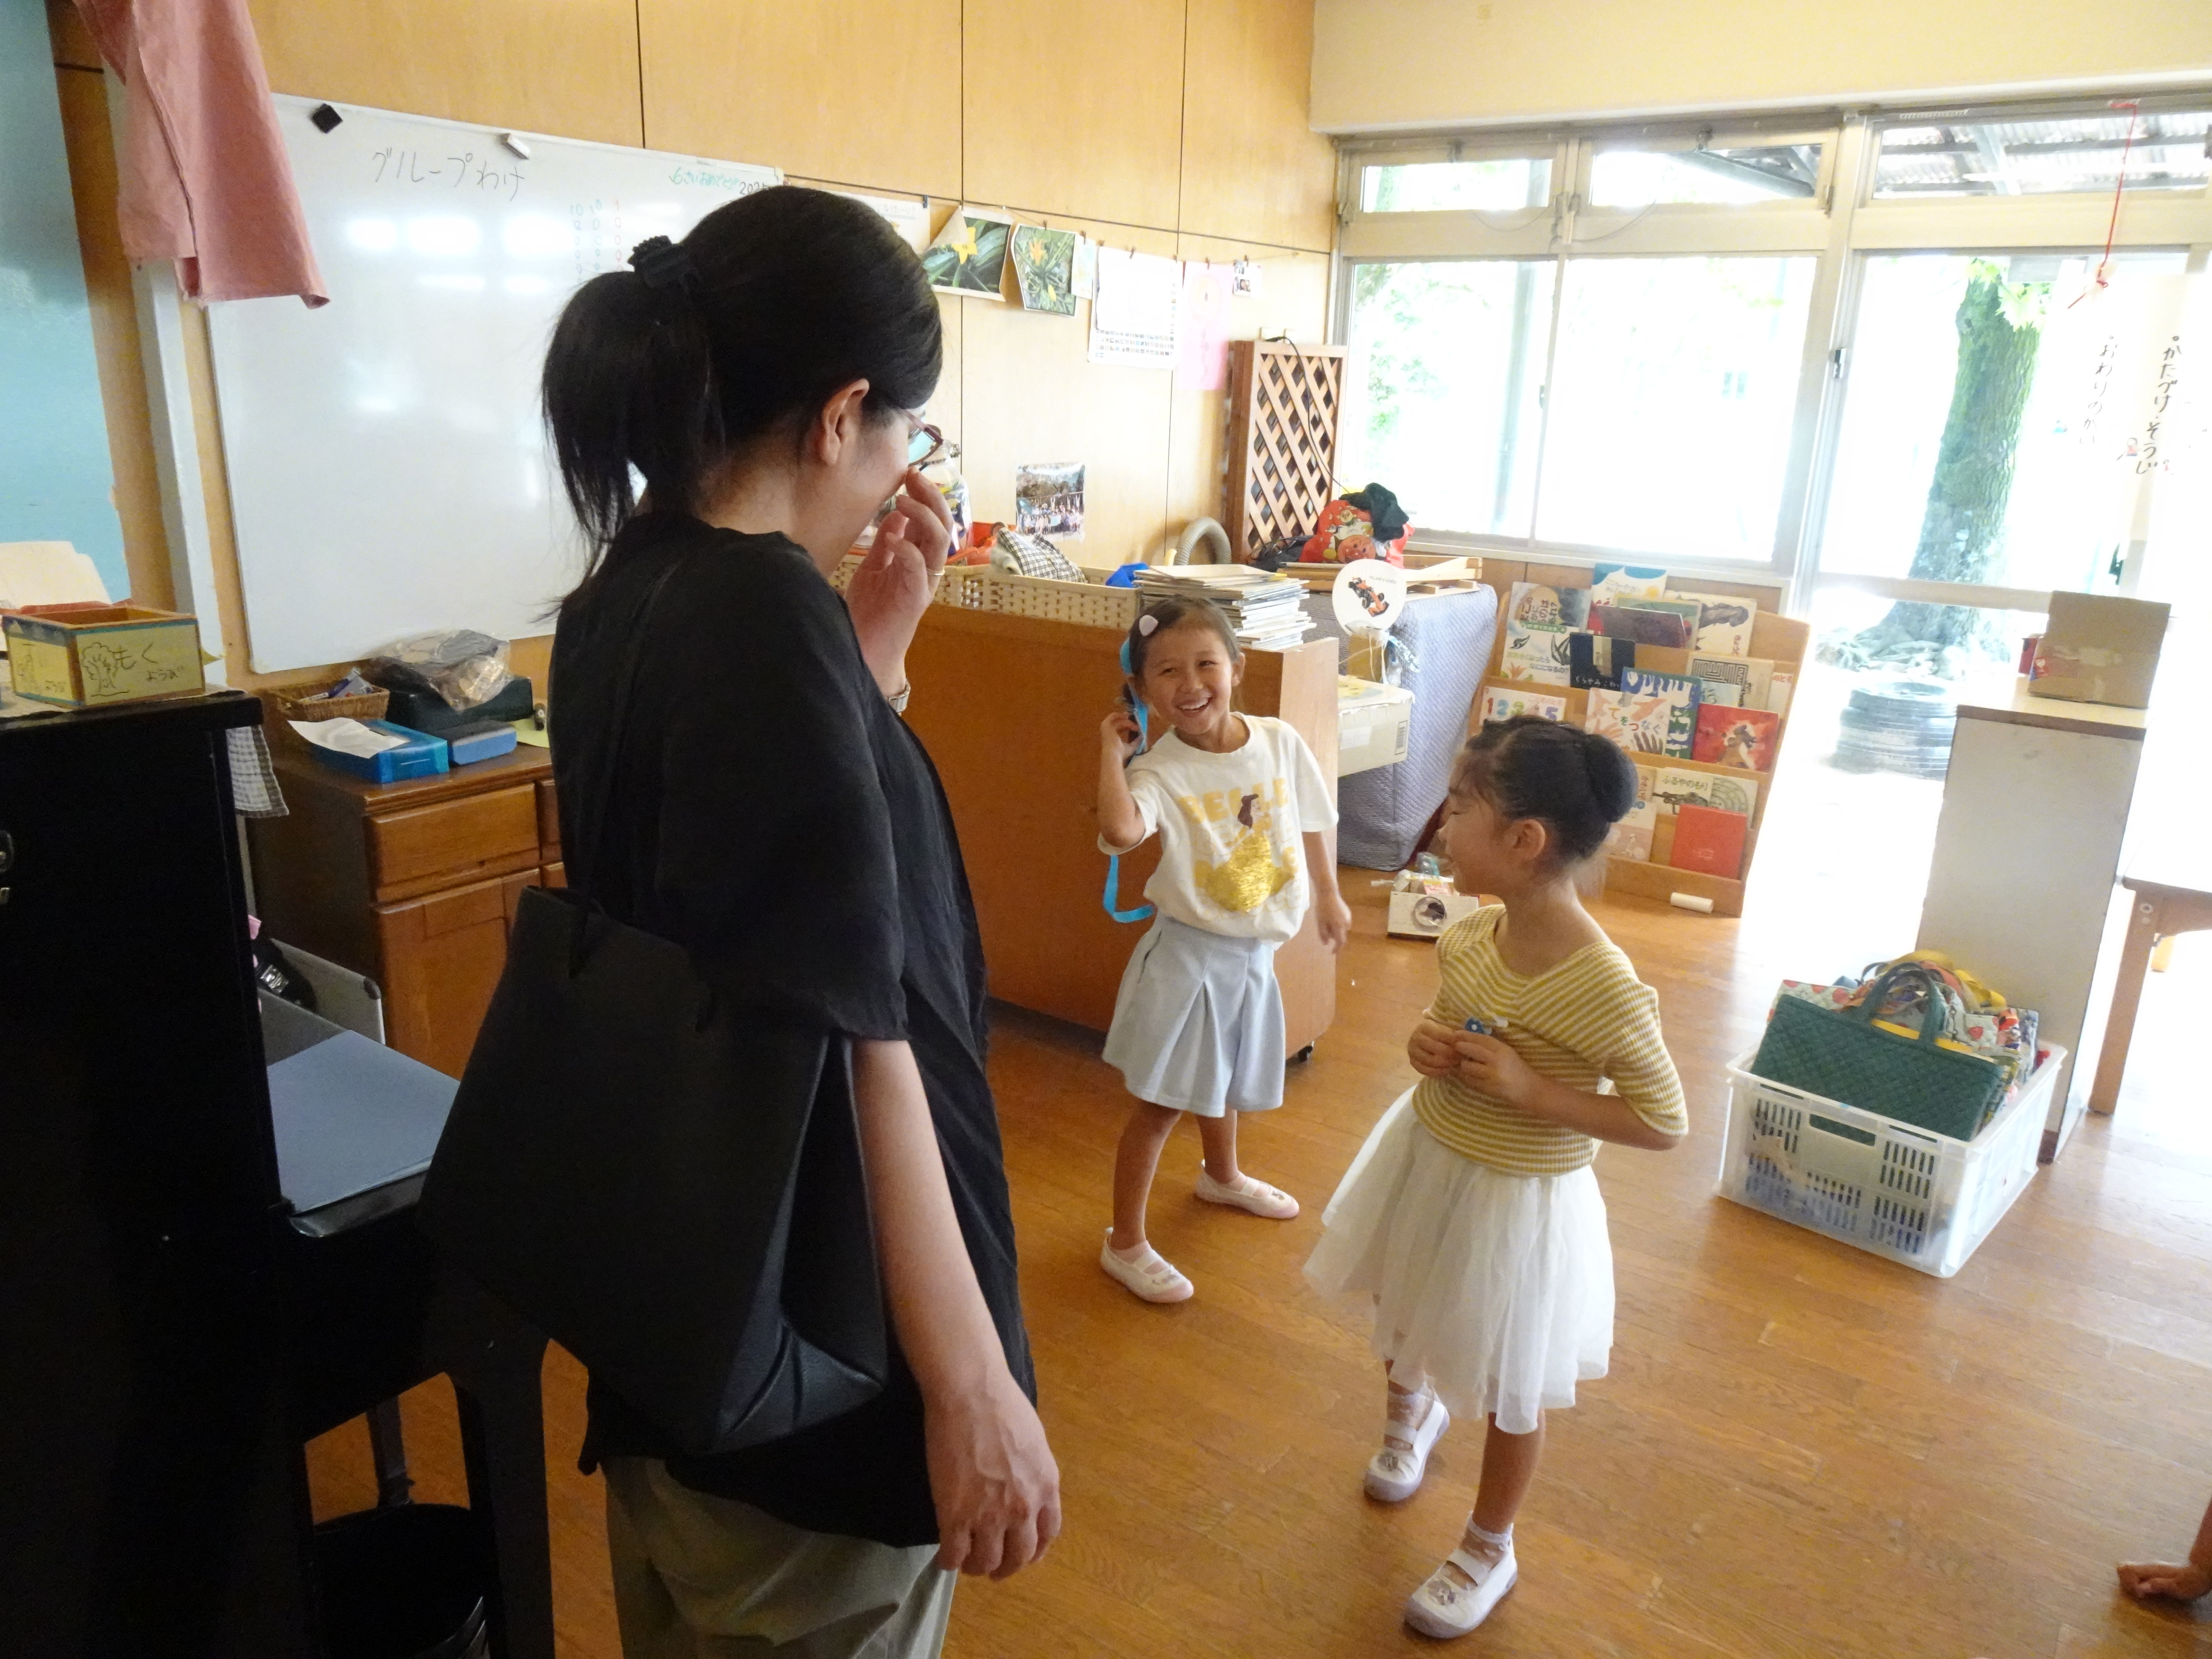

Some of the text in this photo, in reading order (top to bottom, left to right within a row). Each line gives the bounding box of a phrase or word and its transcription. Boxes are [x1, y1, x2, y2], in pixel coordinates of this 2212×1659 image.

[372, 147, 525, 201] グループわけ
[2080, 344, 2117, 444] おわりのかい
